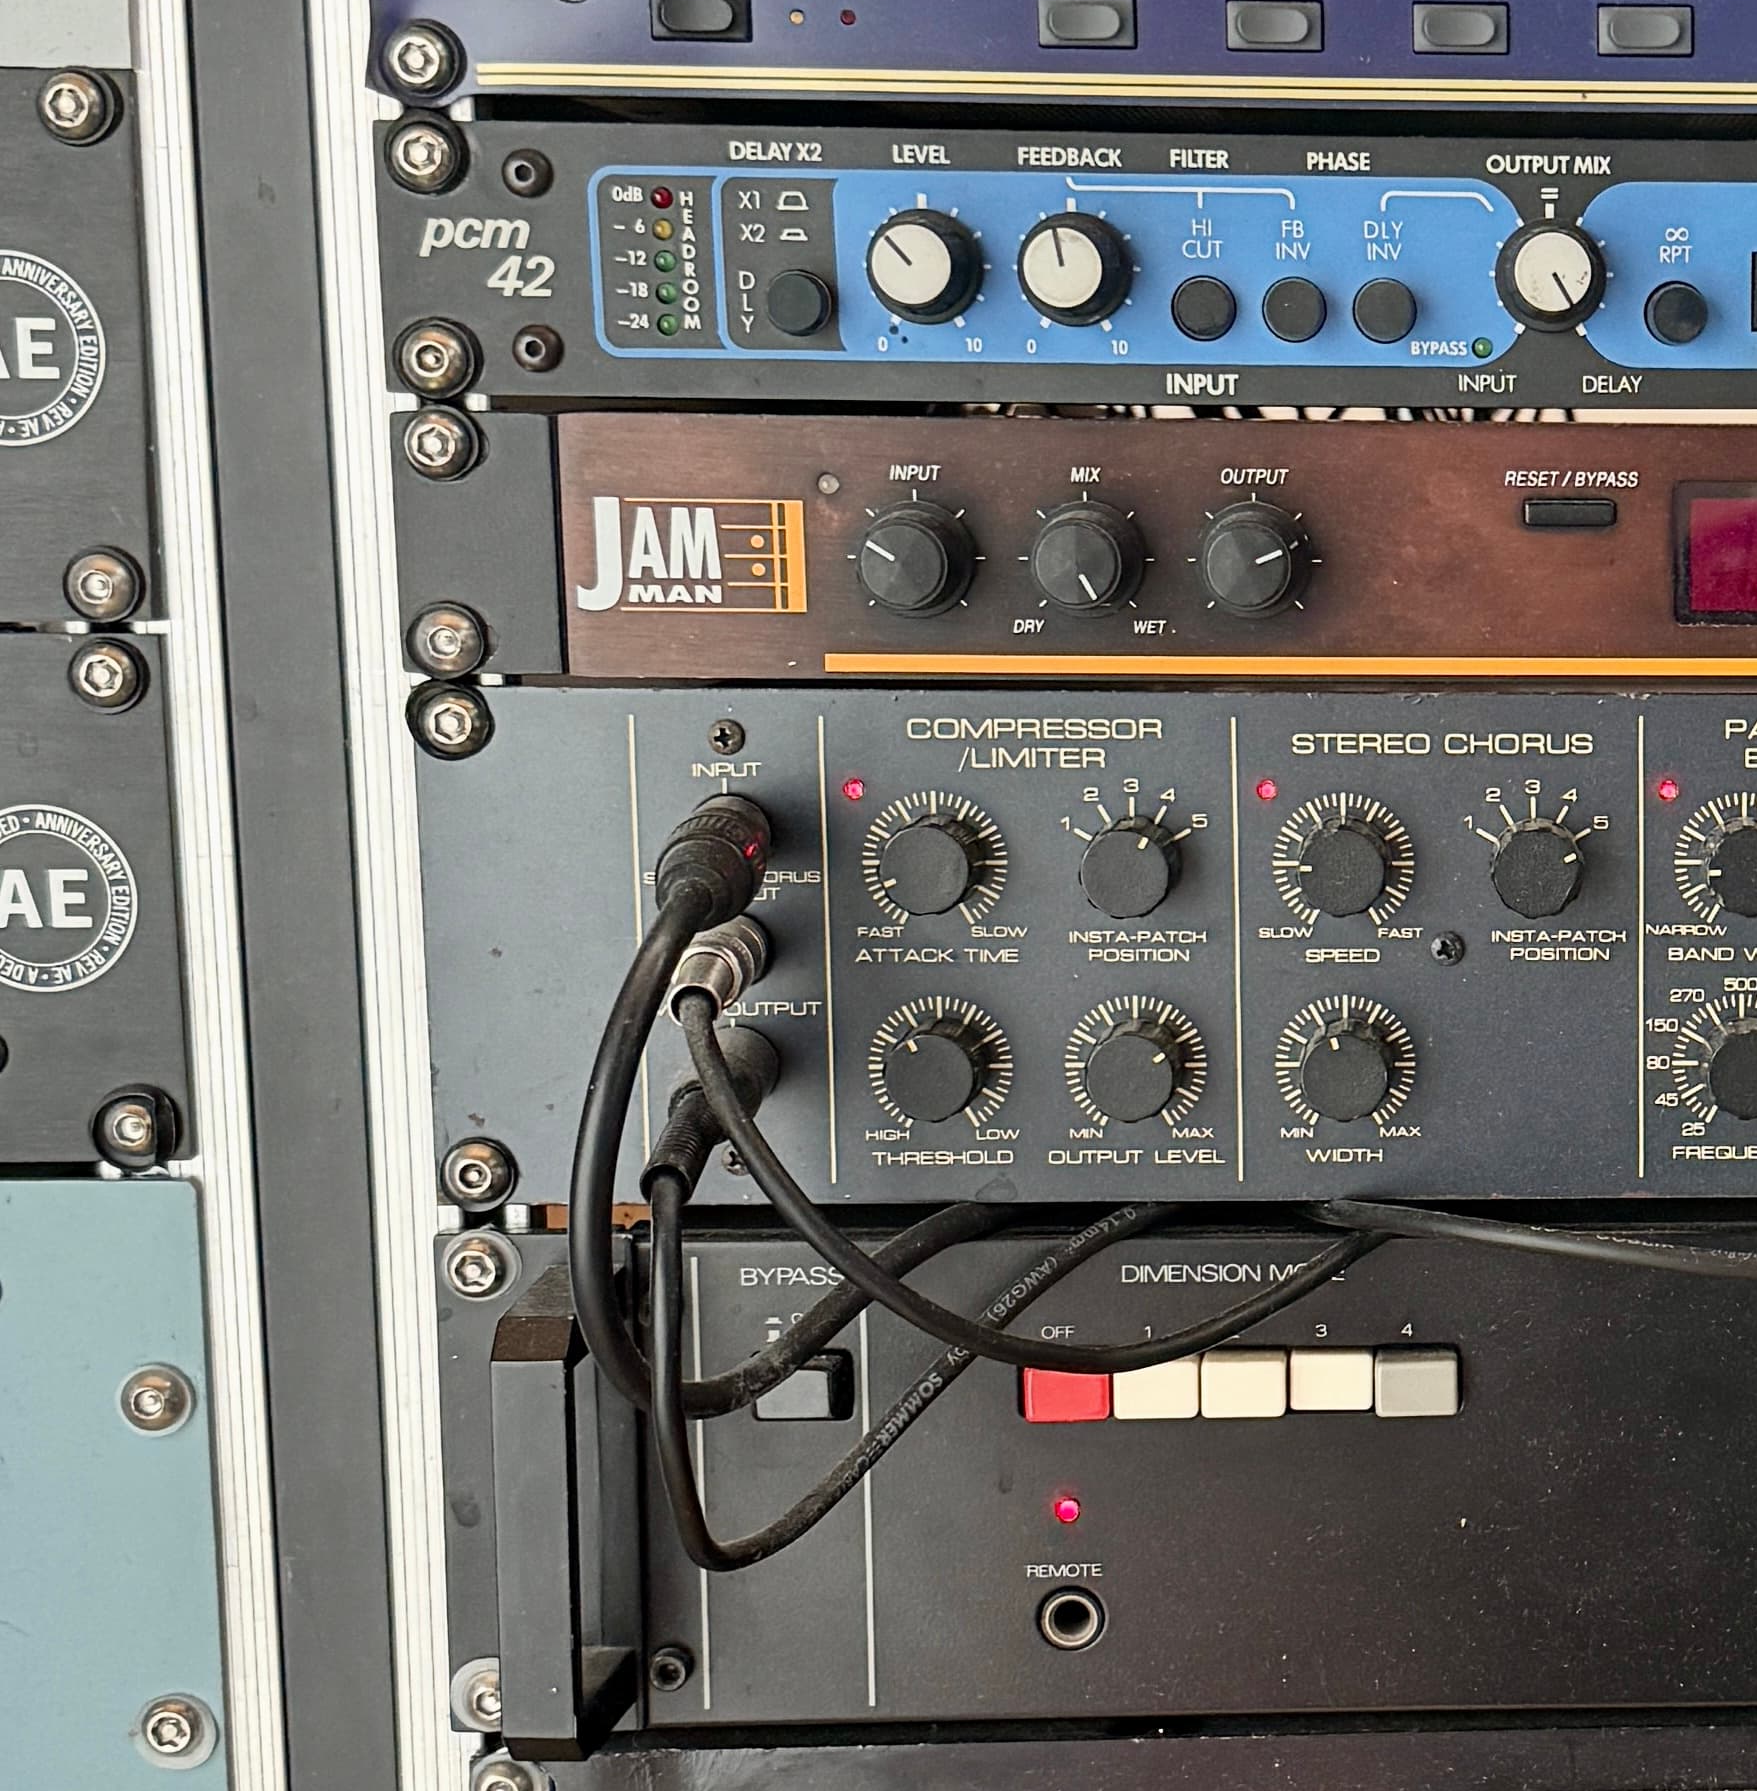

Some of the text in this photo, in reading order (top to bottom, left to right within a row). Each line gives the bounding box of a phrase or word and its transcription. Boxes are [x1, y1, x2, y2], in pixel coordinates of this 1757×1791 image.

[729, 142, 822, 162] DELAY X2
[892, 146, 950, 165] LEVEL
[1018, 147, 1122, 167] FEEDBACK
[1307, 153, 1370, 171] PHASE
[1486, 156, 1610, 175] OUTPUT MIX
[419, 216, 529, 257] pcm
[488, 256, 554, 297] 42
[889, 466, 940, 482] INPUT
[1220, 468, 1288, 486] OUTPUT
[1504, 471, 1639, 487] RESET BYPASS
[629, 584, 722, 604] MAN
[906, 719, 1162, 740] COMPRESSOR
[1292, 734, 1593, 754] STEREO CHORUS
[959, 748, 1106, 772] /LIMITER
[872, 1150, 1014, 1165] THRESHOLD
